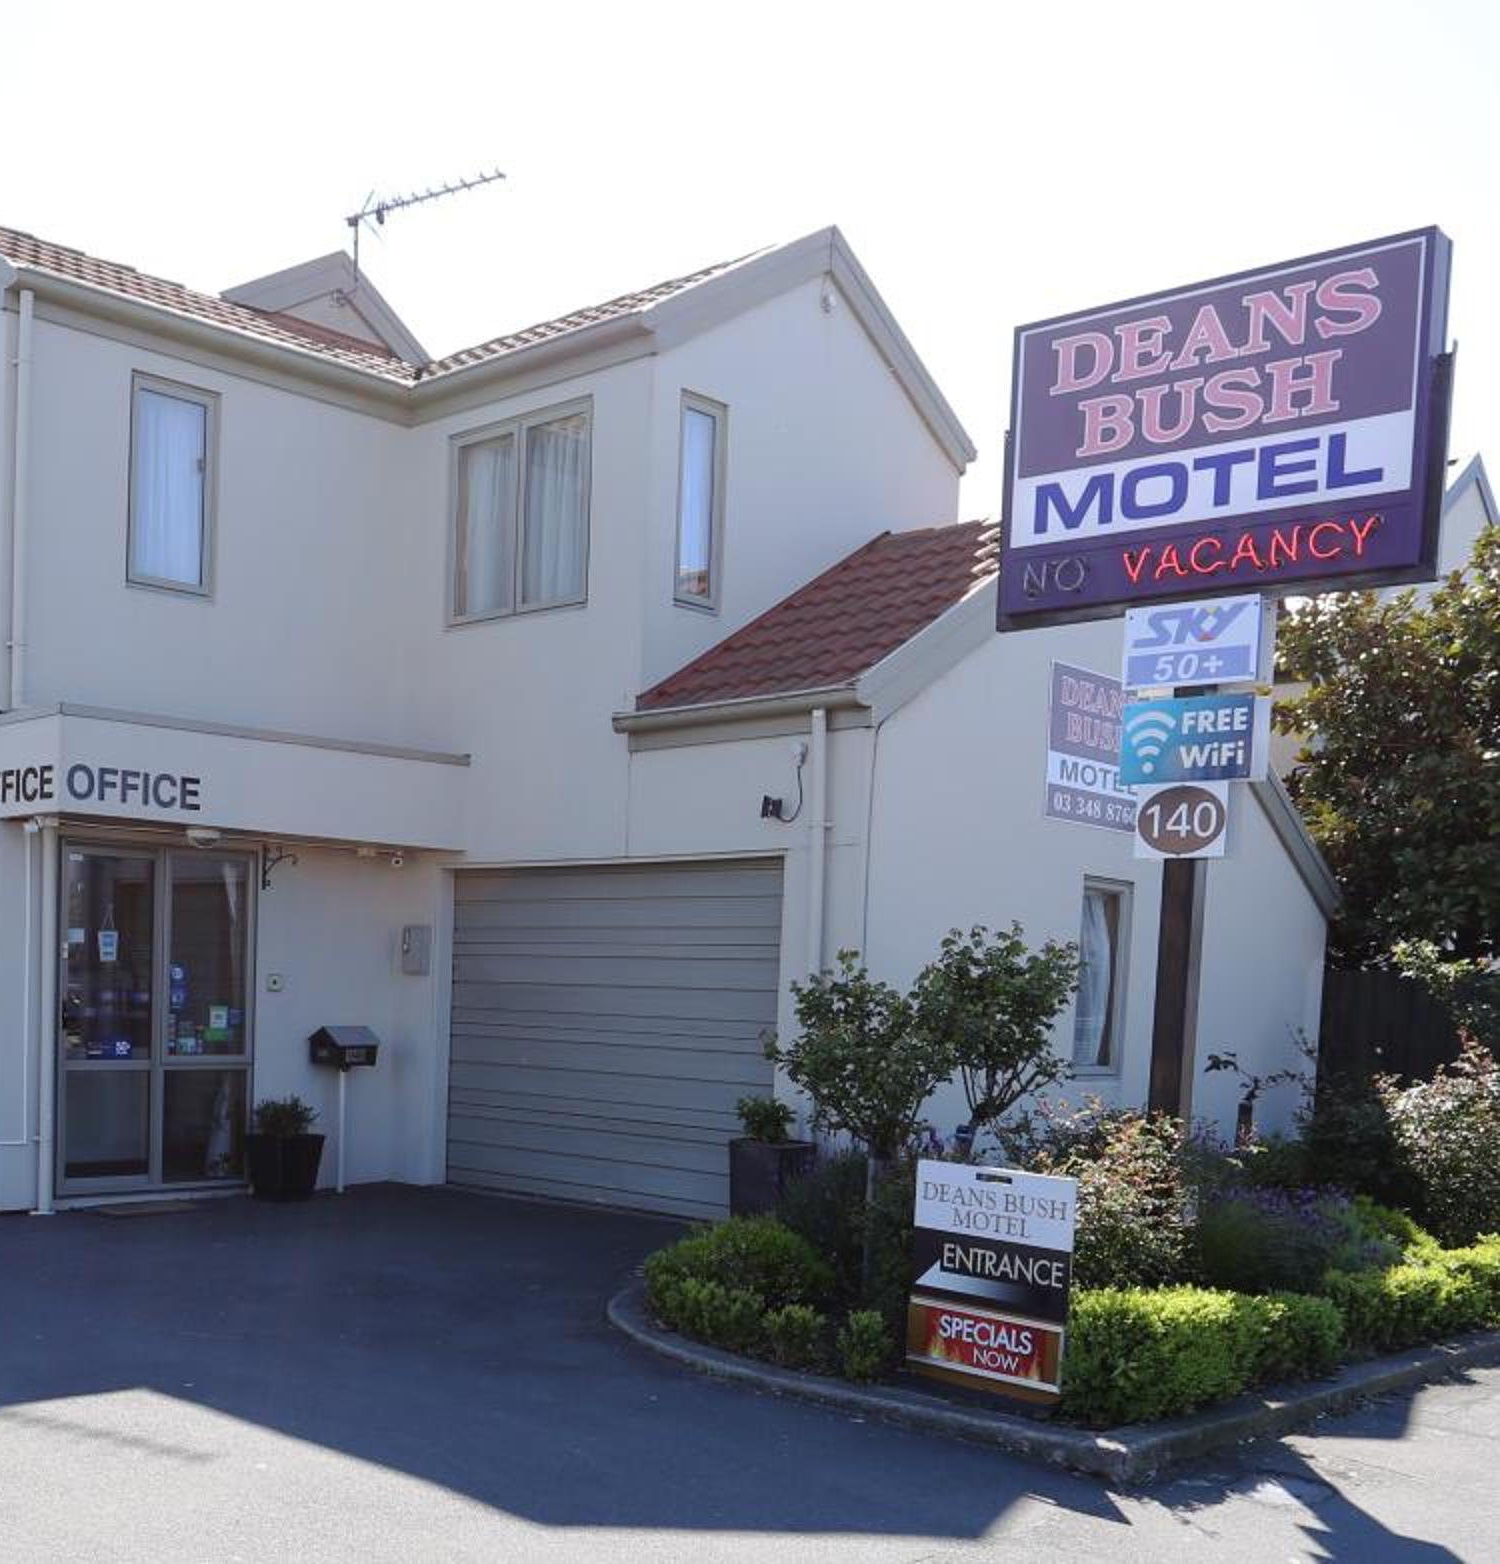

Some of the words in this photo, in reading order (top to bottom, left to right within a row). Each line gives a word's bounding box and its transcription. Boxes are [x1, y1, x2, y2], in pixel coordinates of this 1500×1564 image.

[1050, 267, 1382, 396] DEANS
[1076, 349, 1344, 458] BUSH
[1033, 432, 1384, 534] MOTEL
[1022, 557, 1085, 593] NO
[1123, 514, 1382, 583] VACANCY
[1131, 601, 1251, 648] SKY
[1153, 653, 1224, 681] 50+
[1060, 675, 1141, 718] DEAN
[1181, 706, 1249, 735] FREE
[1180, 741, 1244, 769] WiFi
[66, 763, 201, 811] OFFICE
[1053, 791, 1071, 814] 03
[1075, 796, 1101, 819] 348
[1146, 801, 1218, 839] 140
[923, 1182, 997, 1212] DEANS
[1004, 1193, 1068, 1221] BUSH
[953, 1207, 1029, 1239] MOTEL
[943, 1243, 1064, 1288] ENTRANCE
[938, 1315, 1033, 1355] SPECIALS
[972, 1348, 1020, 1372] NOW
